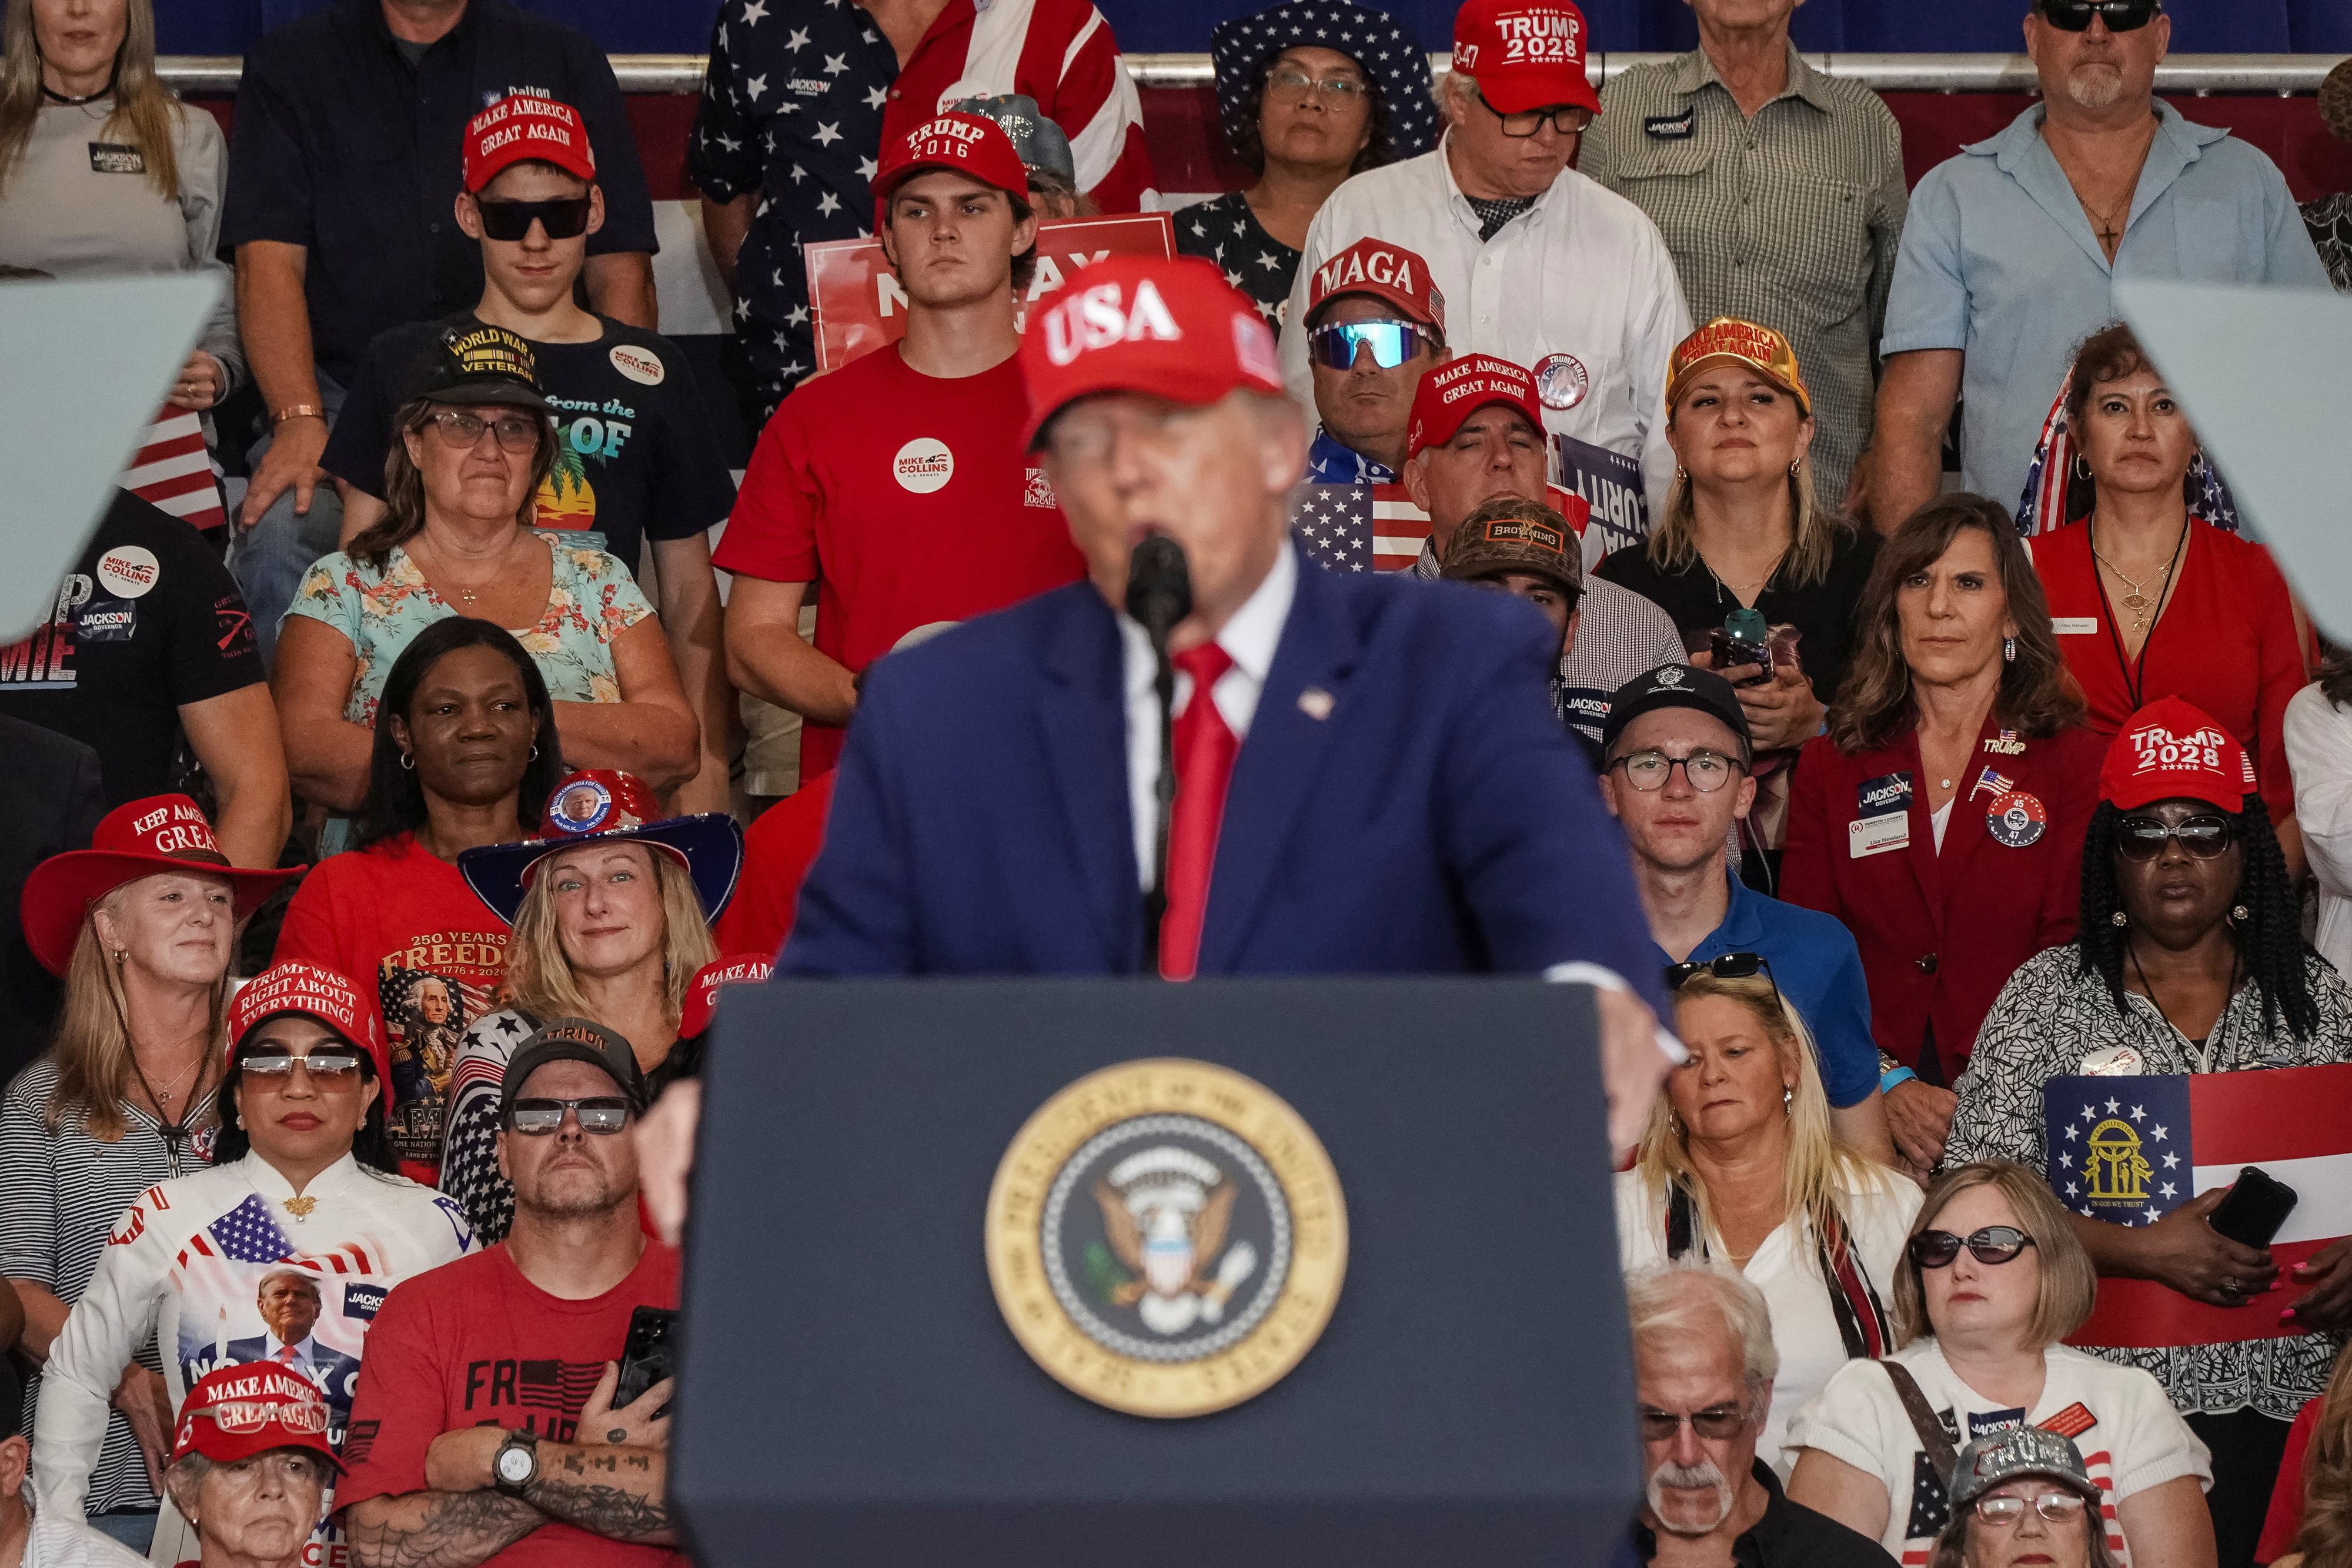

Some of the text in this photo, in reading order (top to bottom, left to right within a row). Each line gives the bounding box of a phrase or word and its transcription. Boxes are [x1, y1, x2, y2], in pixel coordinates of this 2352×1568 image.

[1495, 16, 1579, 40] TRUMP
[1506, 37, 1577, 58] 2028
[472, 99, 573, 135] MAKE AMERICA
[481, 123, 570, 156] GREAT AGAIN
[907, 119, 984, 149] TRUMP
[912, 139, 968, 159] 2016
[1319, 251, 1414, 298] MAGA
[1044, 279, 1183, 366] USA
[449, 329, 500, 356] WORLD
[501, 331, 528, 356] WAR
[1679, 323, 1778, 361] MAKE AMERICA
[1685, 340, 1771, 365] GREAT AGAIN
[462, 361, 534, 383] VETERAN
[615, 355, 658, 377] COLLINS
[1433, 360, 1530, 388] MAKE AMERICA
[1548, 356, 1586, 386] TRUMP RALLY
[1442, 380, 1484, 404] GREAT
[1489, 380, 1525, 401] AGAIN
[544, 394, 636, 418] from the
[570, 417, 632, 459] OF
[898, 457, 924, 466] MIKE
[898, 464, 948, 474] COLLINS
[1025, 490, 1039, 504] DOG
[1577, 469, 1642, 534] URITY
[1494, 526, 1556, 545] BROWNING
[103, 563, 151, 584] COLLINS
[106, 556, 132, 569] MIKE
[121, 577, 140, 586] SENATE
[80, 612, 132, 626] JACKSON
[1579, 710, 1606, 718] GOVERNOR
[1984, 739, 2026, 755] TRUMP
[2130, 727, 2226, 752] TRUMP
[2138, 745, 2220, 769] 2028
[553, 793, 563, 806] SOUTH
[562, 781, 584, 793] CAROLINA
[594, 783, 607, 795] TRUMP
[1863, 781, 1909, 804] JACKSON
[1875, 795, 1900, 807] GOVERNOR
[2013, 800, 2024, 808] 45
[133, 807, 168, 836] KEEP
[1882, 833, 1906, 842] Newland
[2009, 831, 2019, 840] 47
[412, 932, 507, 947] 250 YEARS
[382, 944, 502, 982] FREED
[442, 966, 466, 975] 1776
[249, 963, 348, 992] TRUMP WAS
[700, 964, 746, 988] MAKE
[240, 977, 356, 1014] RIGHT ABOUT
[241, 995, 355, 1028] EVERYTHING!
[2093, 1121, 2134, 1138] CONSTITUTION
[348, 1292, 385, 1307] JACKS
[206, 1376, 261, 1403] MAKE
[219, 1402, 278, 1429] GREAT
[1971, 1419, 2020, 1435] JACKSON
